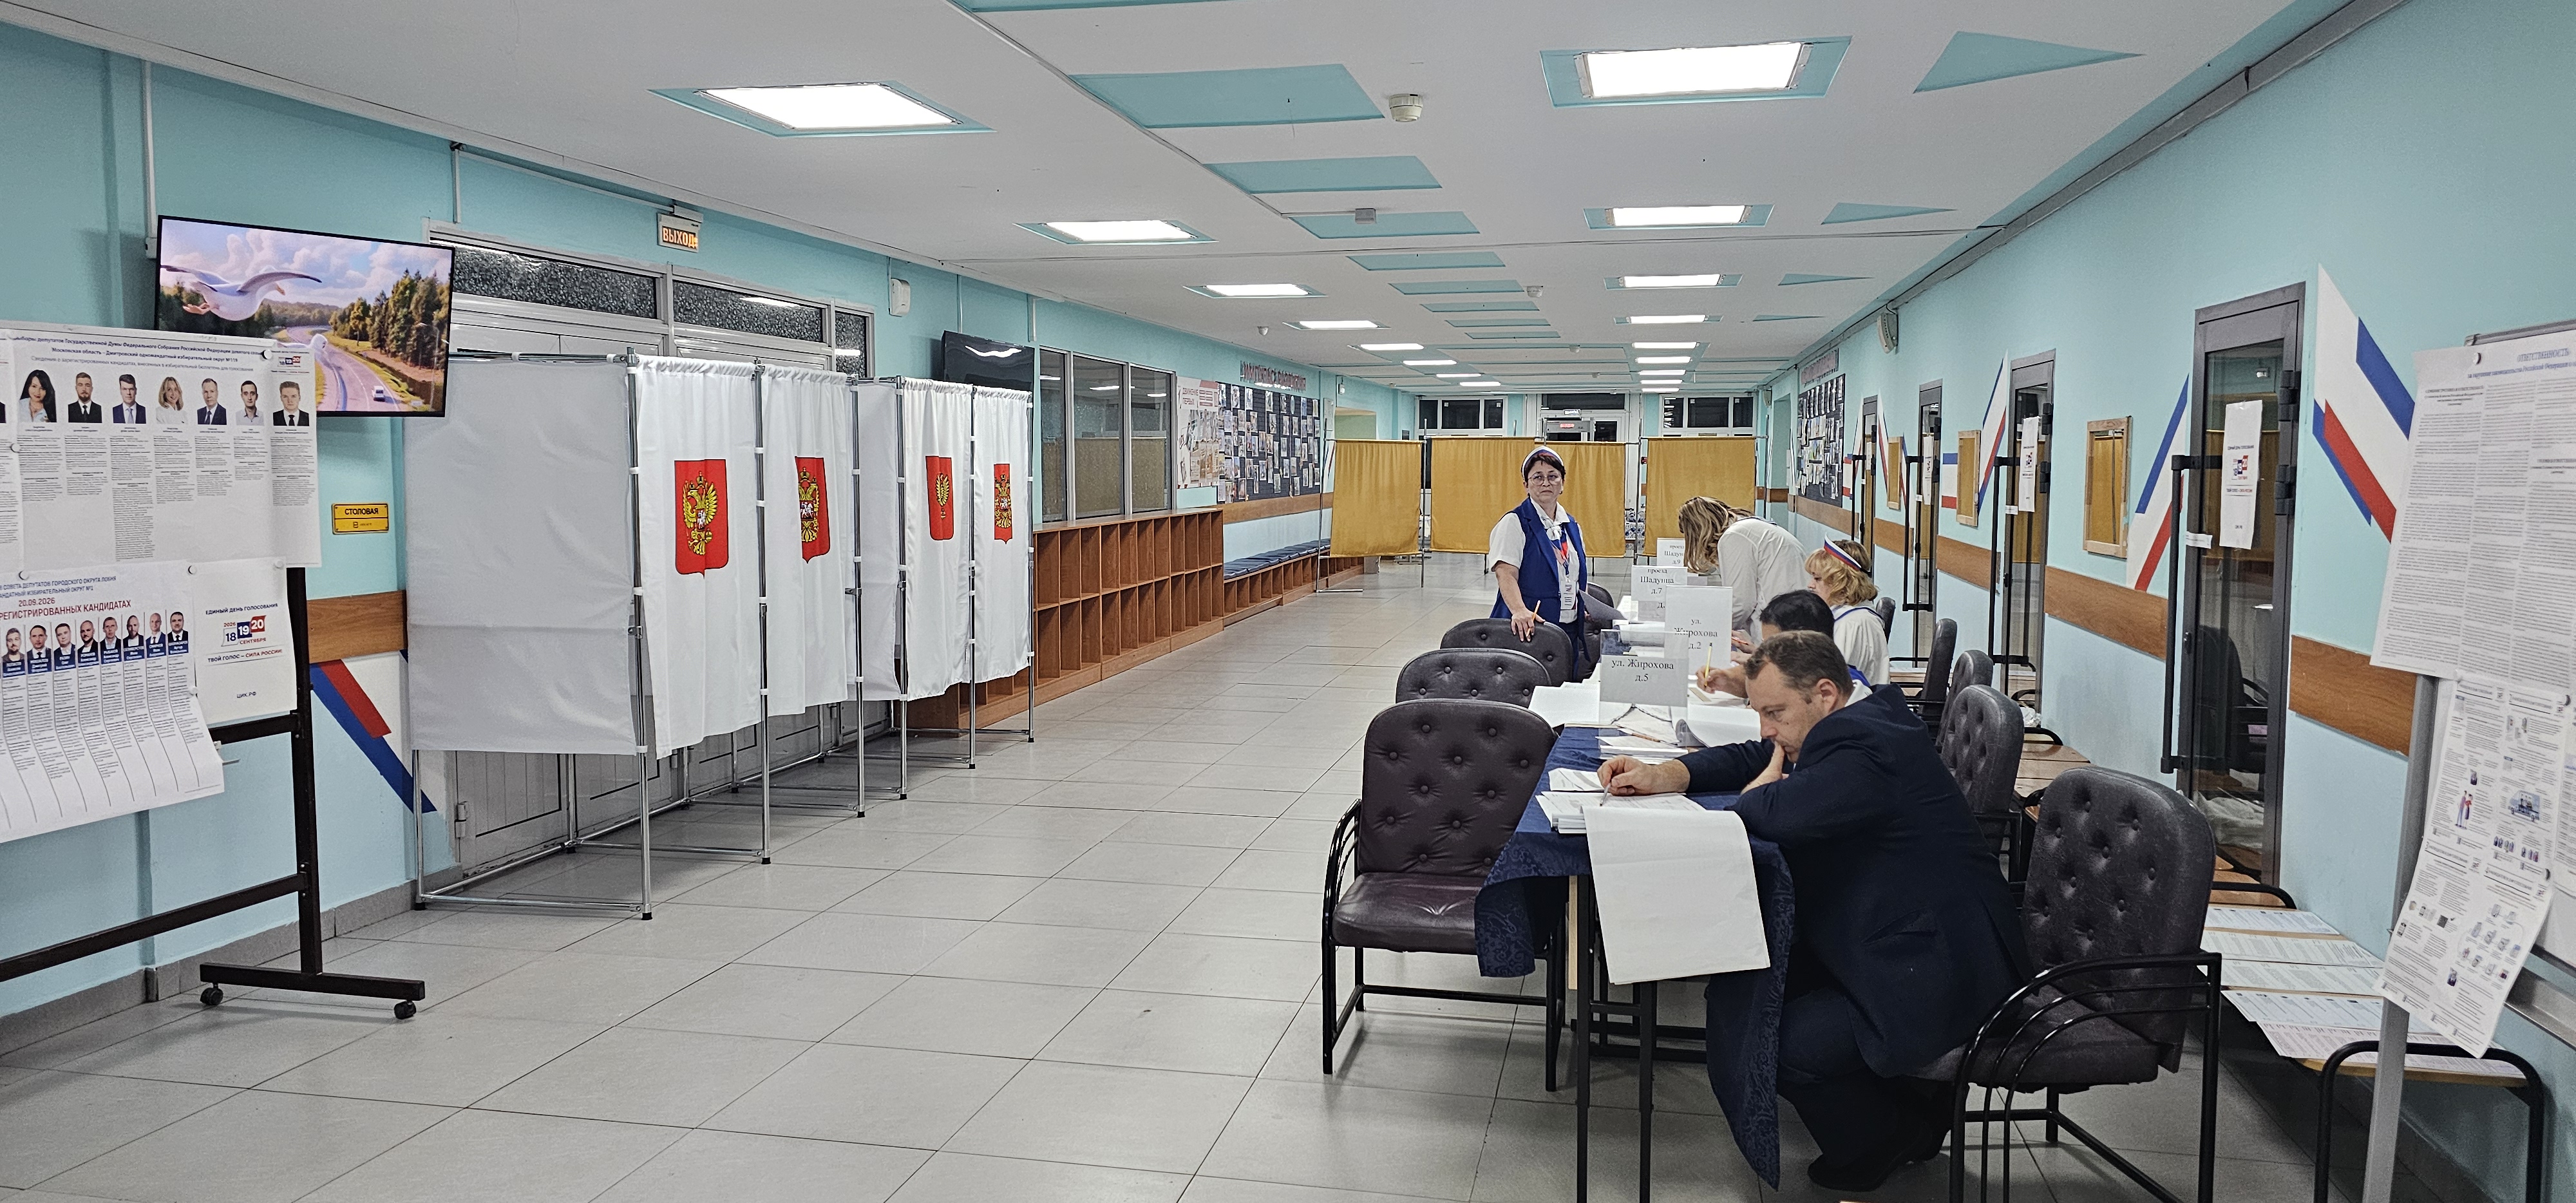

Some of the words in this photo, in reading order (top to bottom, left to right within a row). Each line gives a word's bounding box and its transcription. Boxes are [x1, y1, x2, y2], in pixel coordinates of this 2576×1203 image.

[663, 227, 695, 248] ВЫХОД
[27, 587, 70, 596] ИЗБИРАТЕЛЬНЫЙ
[19, 598, 55, 607] 20.09.2026
[84, 600, 131, 612] КАНДИДАТАХ
[251, 620, 264, 629] 20
[238, 625, 250, 636] 19
[225, 632, 236, 641] 18
[1611, 660, 1625, 668] ул.
[1627, 659, 1674, 670] Жирохова
